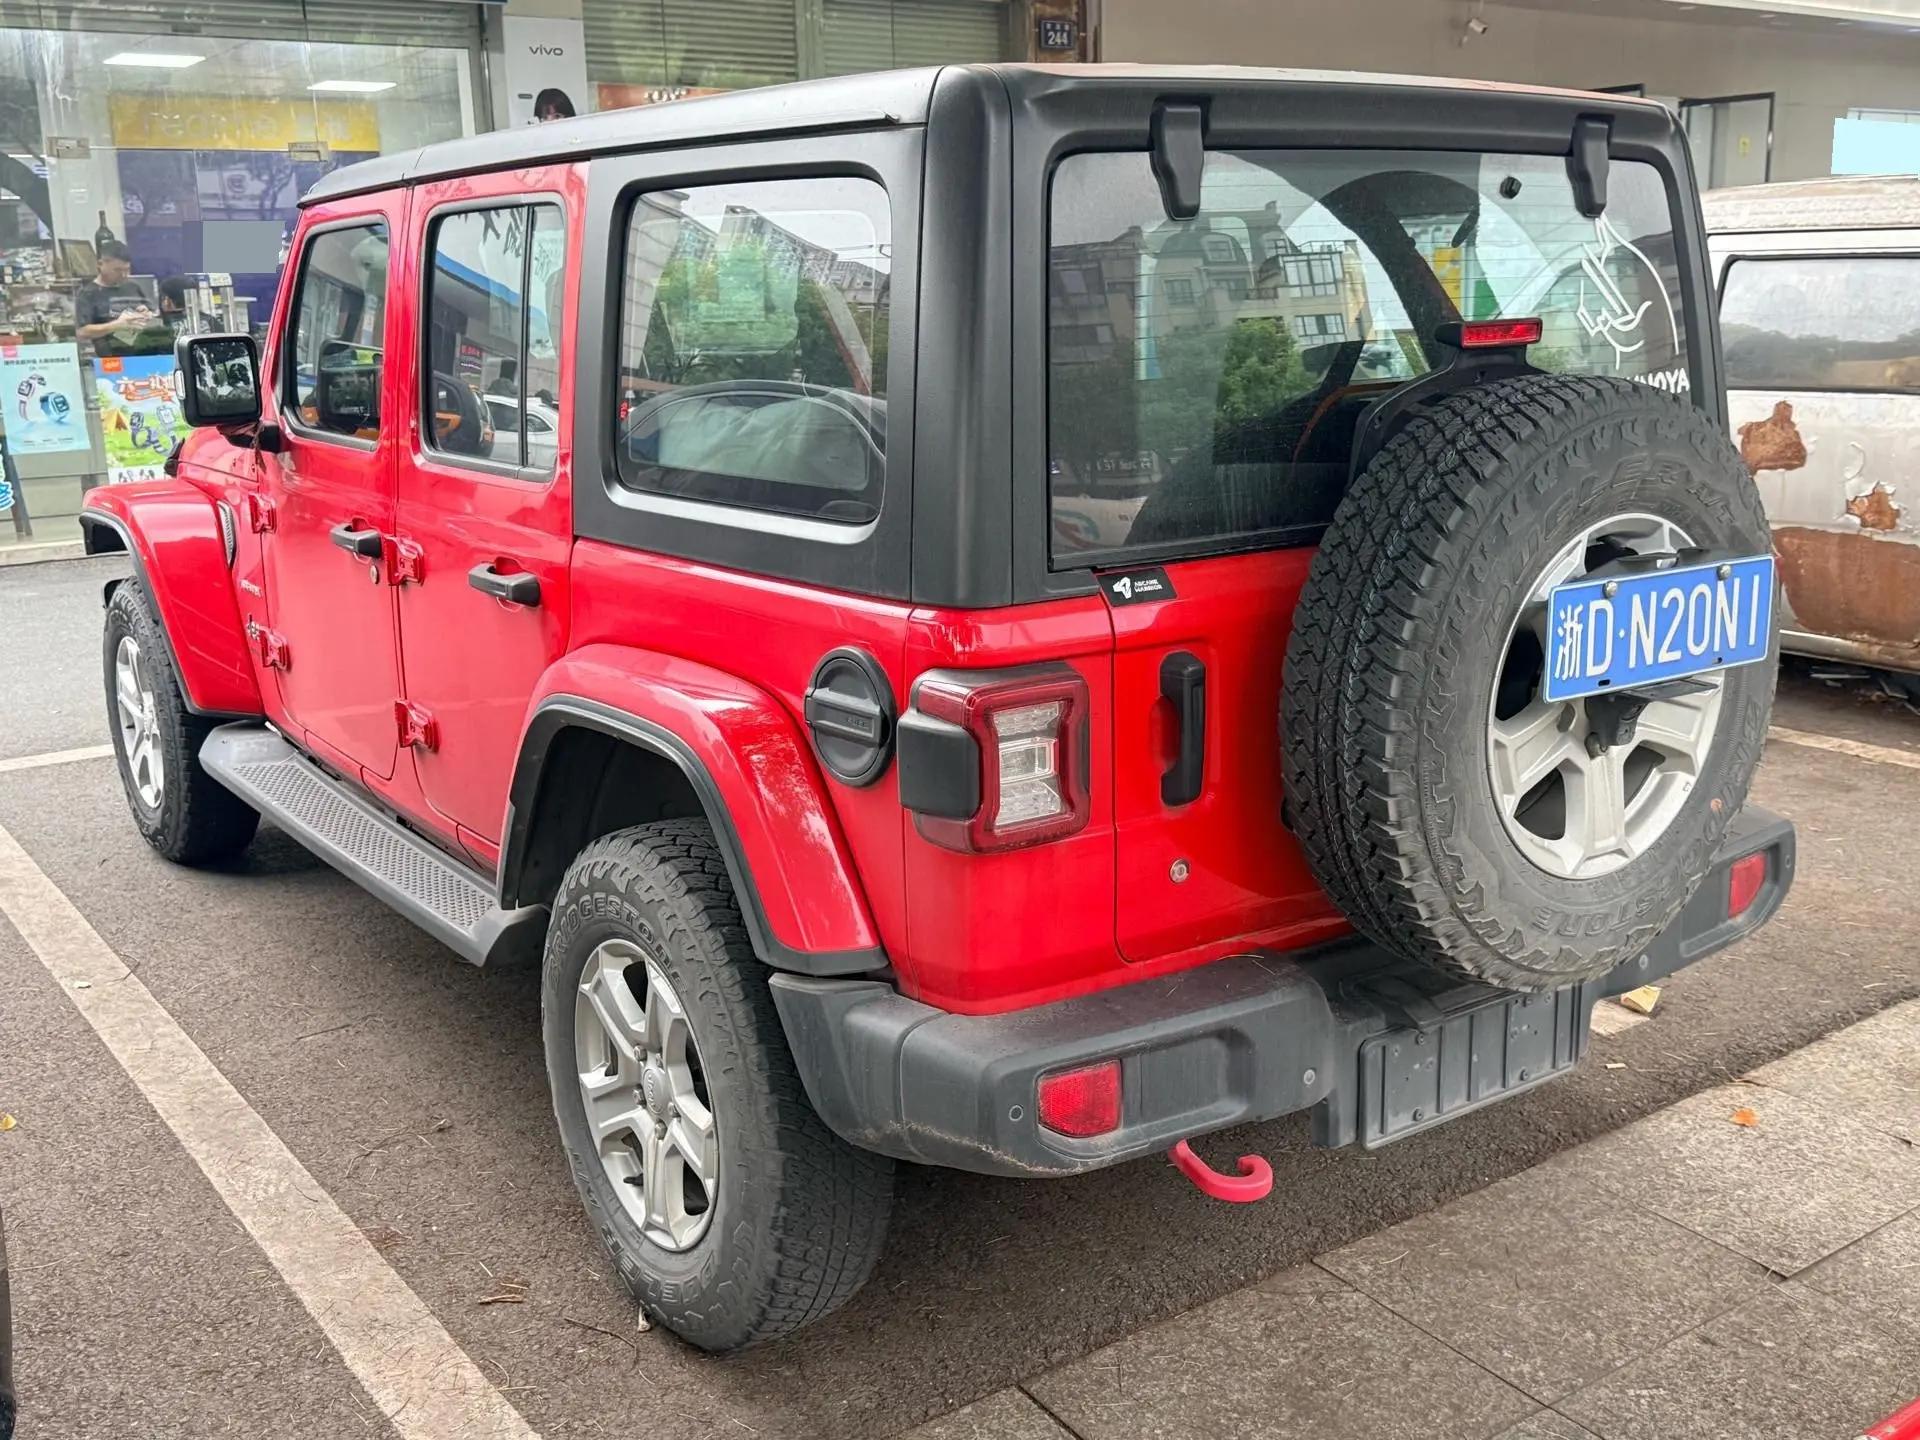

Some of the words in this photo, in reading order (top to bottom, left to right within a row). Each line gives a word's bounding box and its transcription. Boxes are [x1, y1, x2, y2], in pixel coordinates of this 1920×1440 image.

[1047, 31, 1069, 45] 244
[529, 44, 564, 57] vivo
[1134, 584, 1163, 592] WARRIOR
[547, 891, 689, 993] BRIDGESTONE
